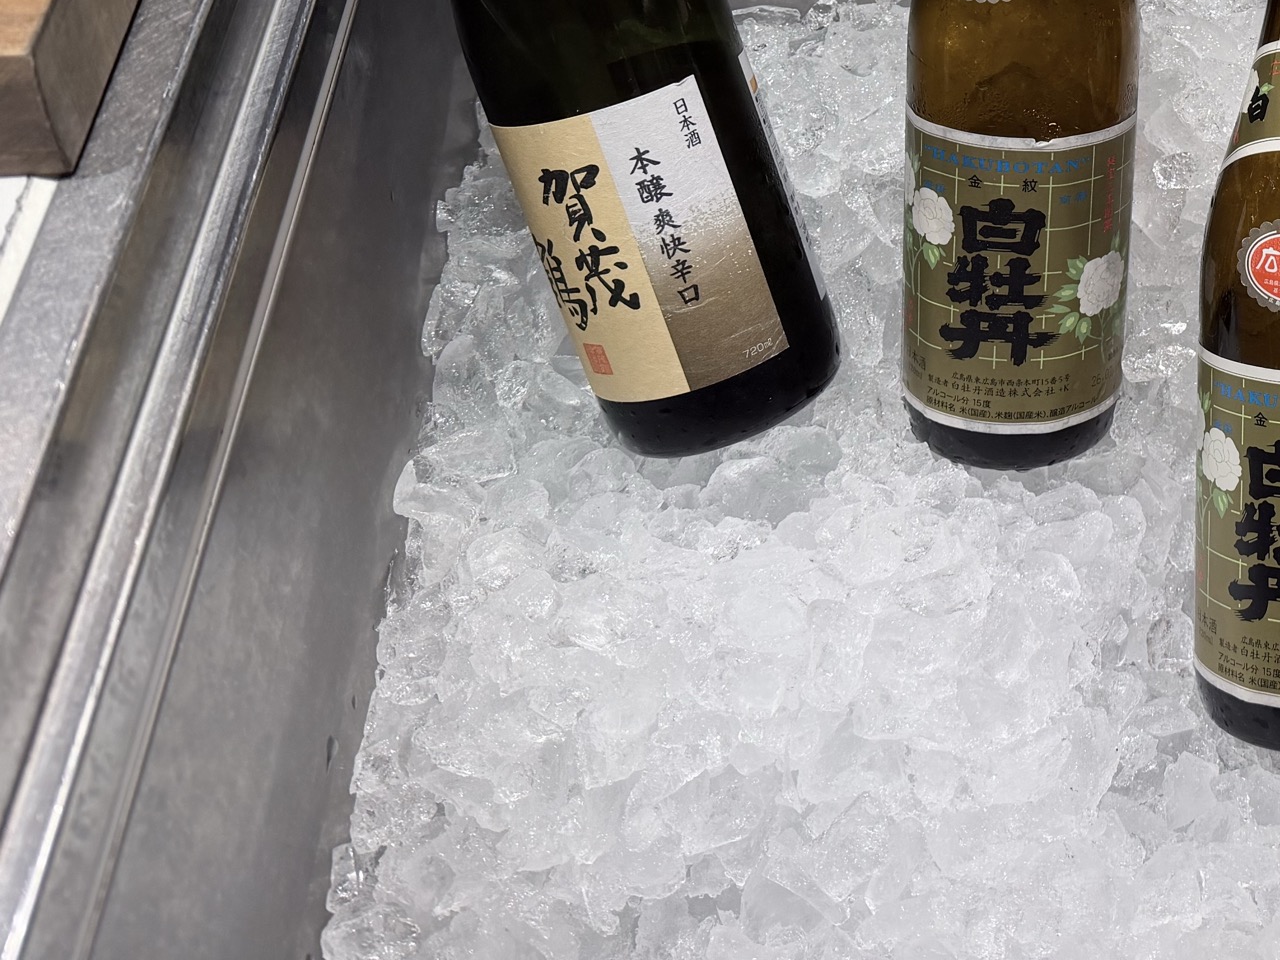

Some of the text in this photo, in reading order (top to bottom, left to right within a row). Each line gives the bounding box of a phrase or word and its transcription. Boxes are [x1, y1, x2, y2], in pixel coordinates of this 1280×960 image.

[672, 97, 702, 150] 日本酒
[938, 197, 1061, 367] 白牡丹
[1218, 651, 1258, 675] アルコール分
